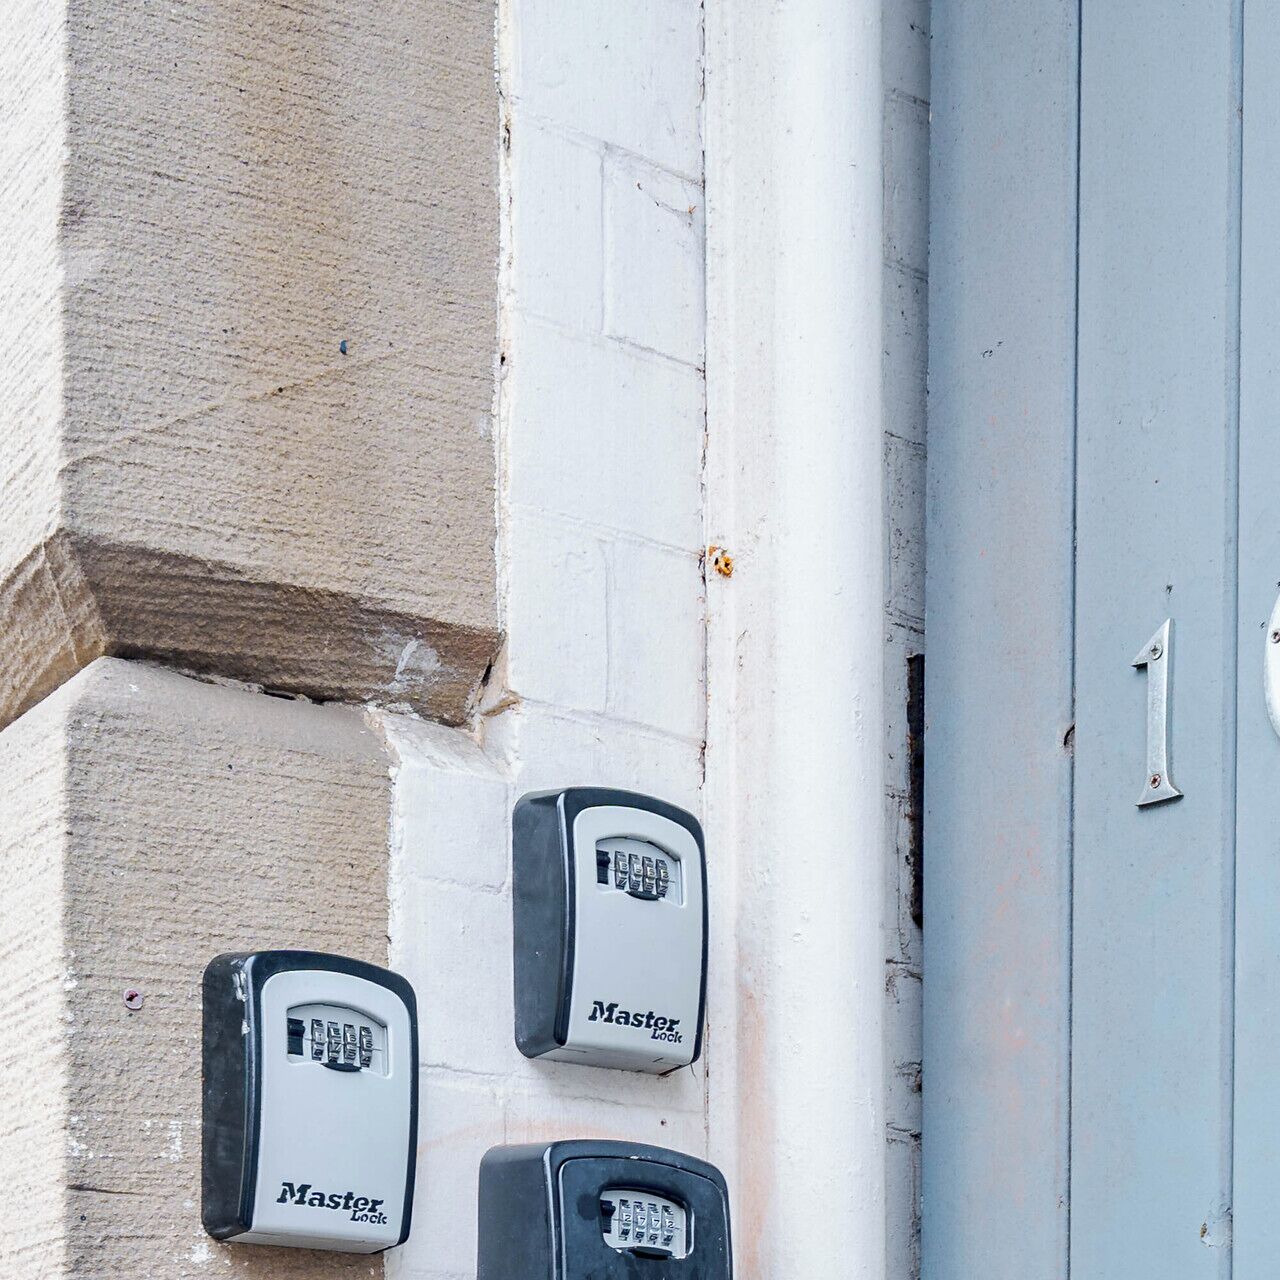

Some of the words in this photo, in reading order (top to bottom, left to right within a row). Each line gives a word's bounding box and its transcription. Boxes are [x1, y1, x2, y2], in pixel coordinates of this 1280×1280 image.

[588, 1000, 680, 1032] Master
[651, 1028, 683, 1043] Lock
[276, 1182, 384, 1213] Master
[350, 1209, 387, 1224] Lock
